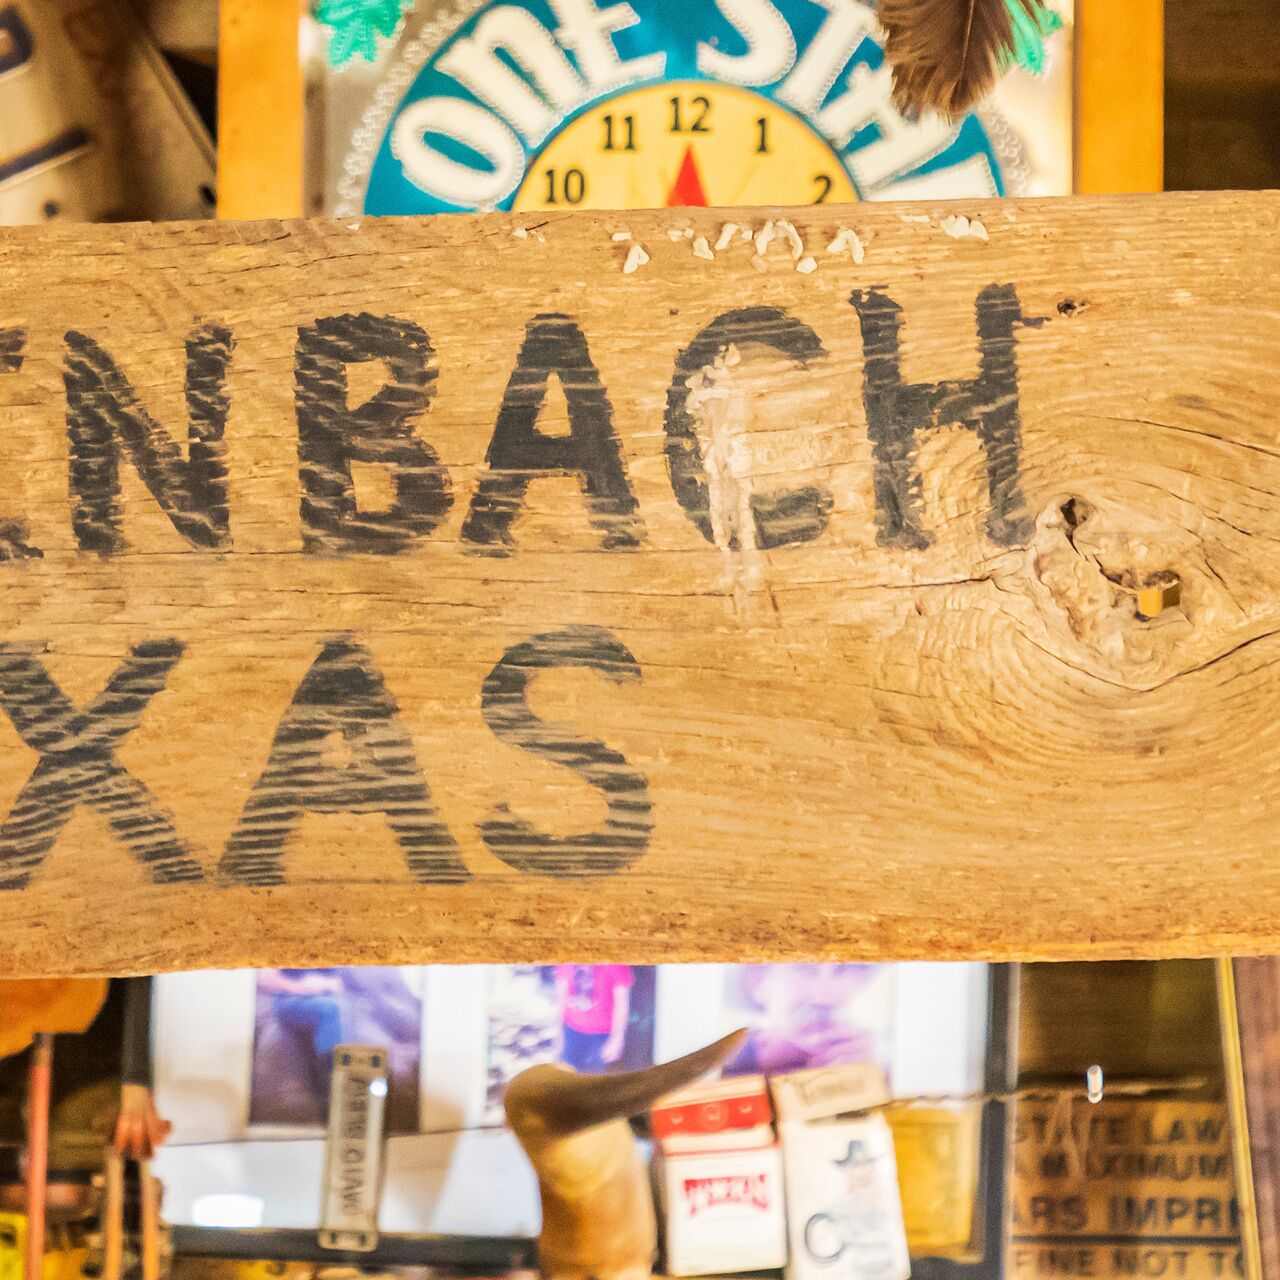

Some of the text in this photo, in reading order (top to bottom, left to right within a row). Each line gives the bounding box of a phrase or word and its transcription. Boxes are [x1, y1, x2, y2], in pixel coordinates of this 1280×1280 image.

[668, 96, 710, 133] 12
[602, 115, 637, 151] 11
[754, 117, 768, 154] 1
[545, 168, 585, 204] 10
